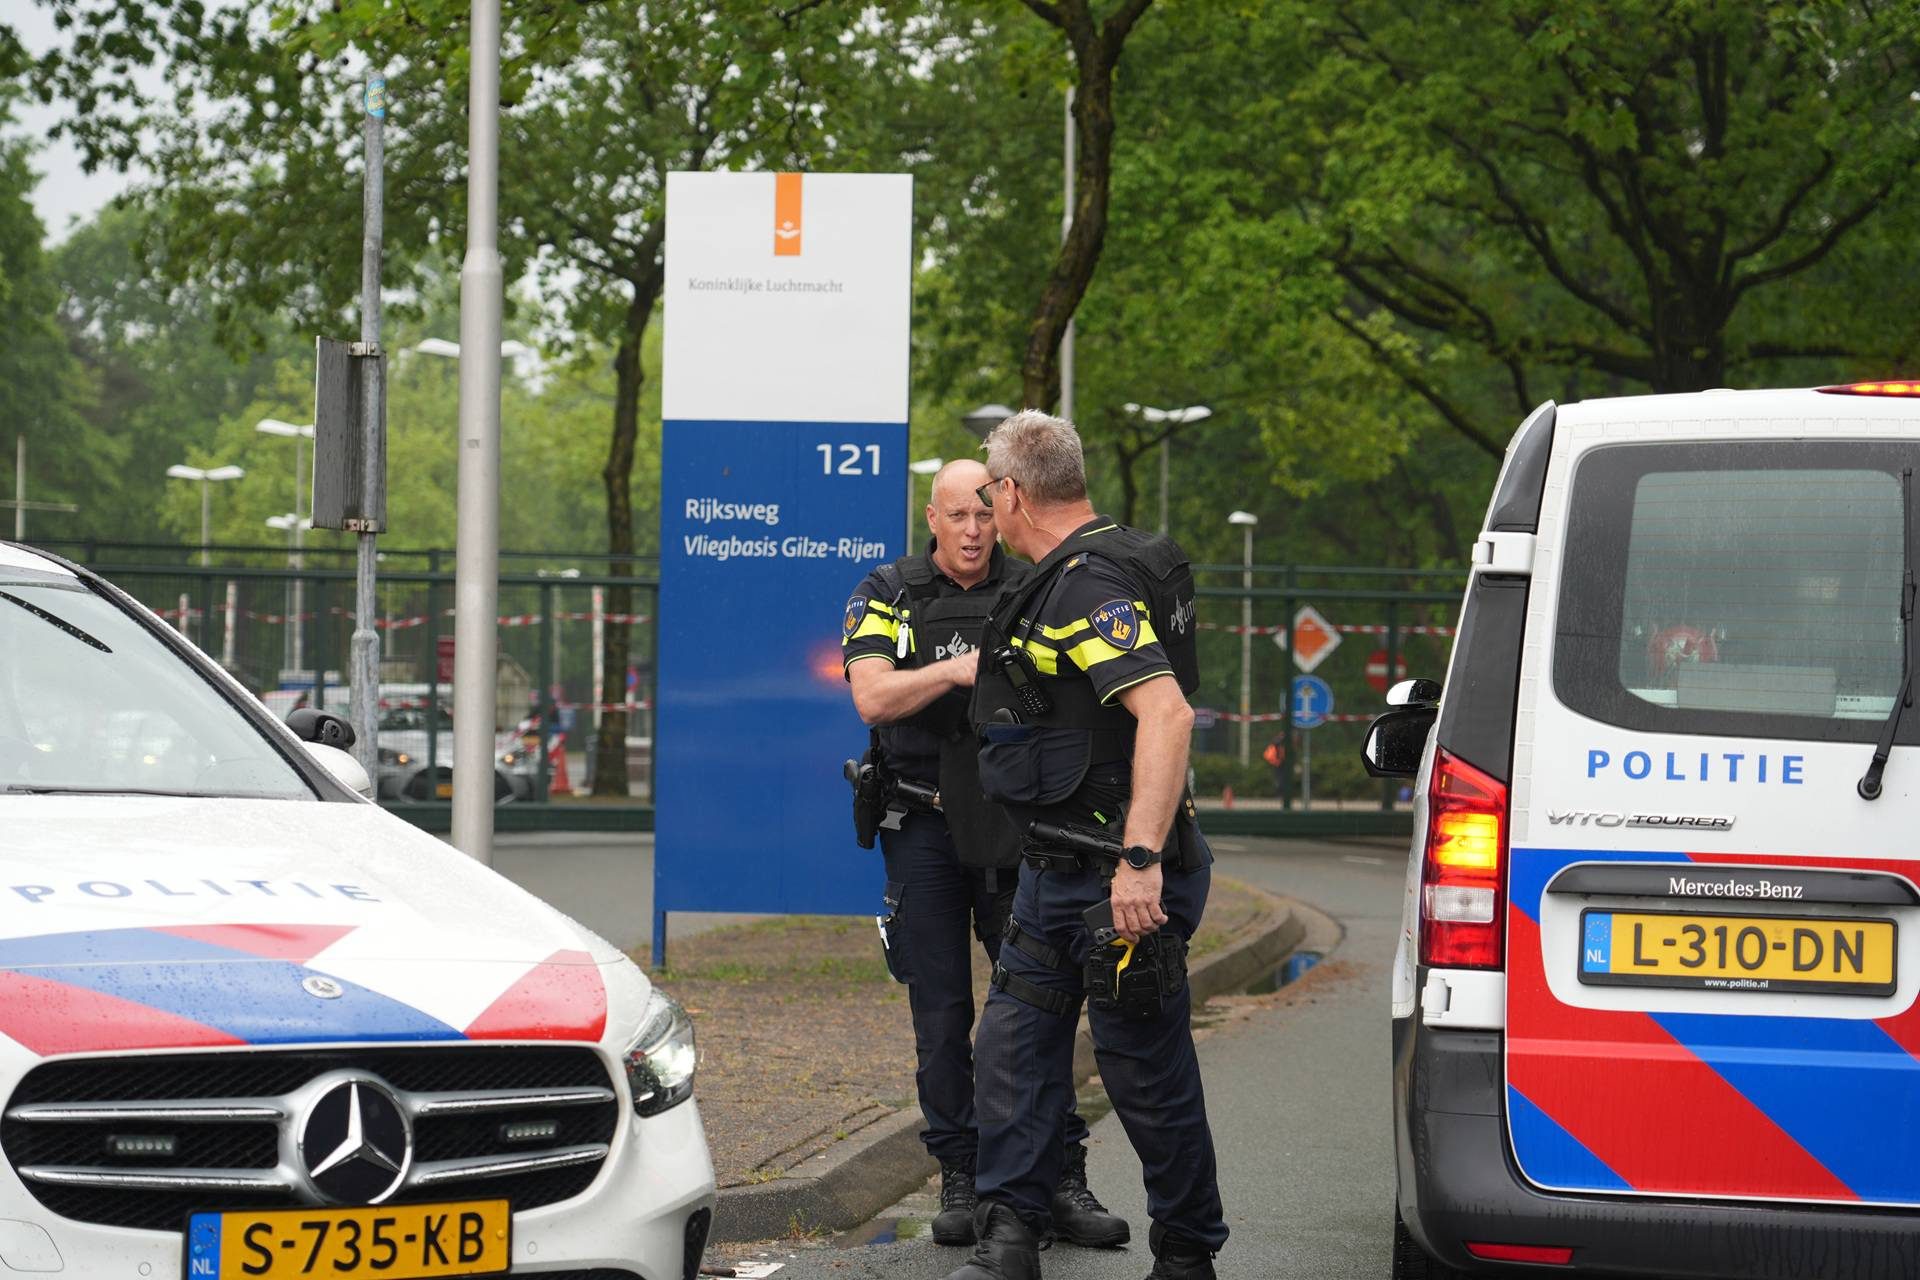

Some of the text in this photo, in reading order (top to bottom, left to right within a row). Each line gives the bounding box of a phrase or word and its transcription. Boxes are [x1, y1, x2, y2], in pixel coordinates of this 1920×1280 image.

[688, 277, 844, 294] Koninklijke Luchtmacht
[816, 443, 881, 475] 121
[685, 498, 779, 526] Rijksweg
[684, 535, 885, 563] Vliegbasis Gilze-Rijen
[1095, 604, 1130, 624] POLITIE
[1171, 597, 1196, 634] POLITI
[1587, 749, 1804, 785] POLITIE
[1545, 807, 1730, 828] VITO TOURER
[11, 878, 383, 904] POLITIE
[1668, 876, 1803, 899] Mercedes-Benz
[1586, 950, 1607, 964] NL
[1632, 922, 1865, 974] L-310-DN
[1704, 978, 1769, 990] www.politie.nl
[241, 1211, 484, 1276] S-735-KB
[191, 1257, 216, 1276] NL
